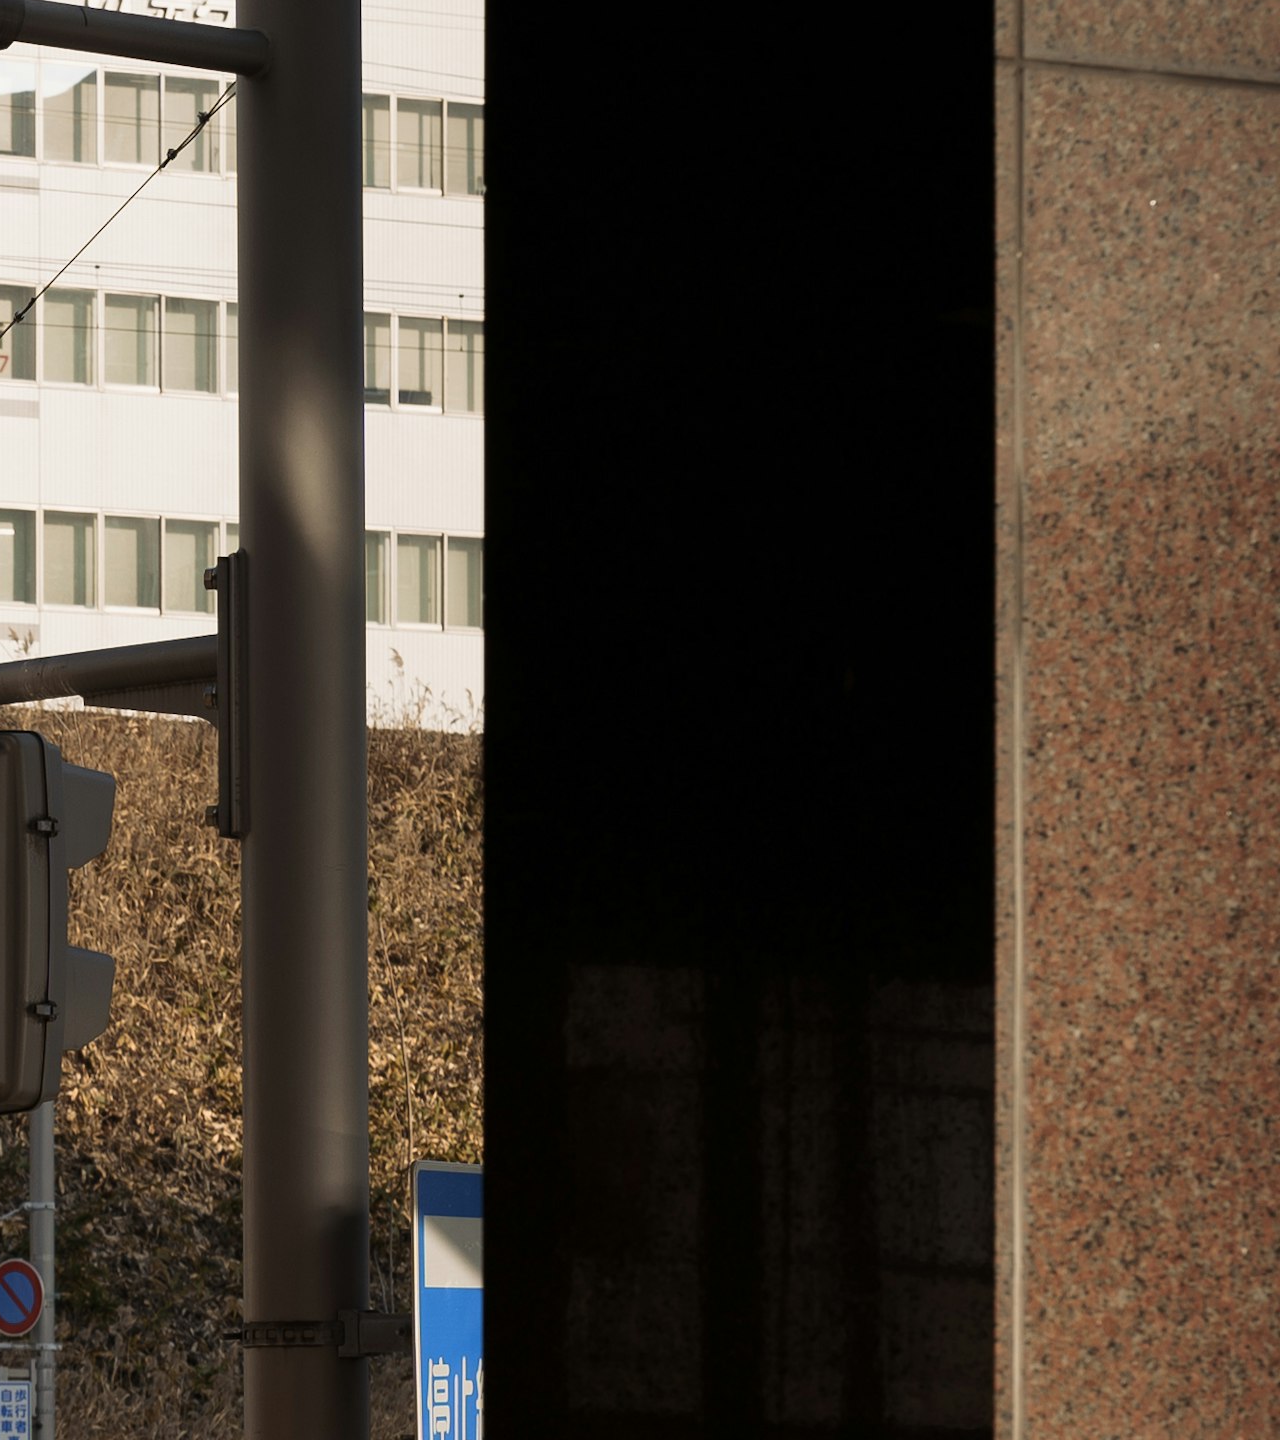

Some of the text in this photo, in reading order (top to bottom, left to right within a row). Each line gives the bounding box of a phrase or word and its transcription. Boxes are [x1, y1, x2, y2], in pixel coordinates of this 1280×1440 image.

[1, 1389, 13, 1434] 自転車
[15, 1389, 27, 1434] 歩行者
